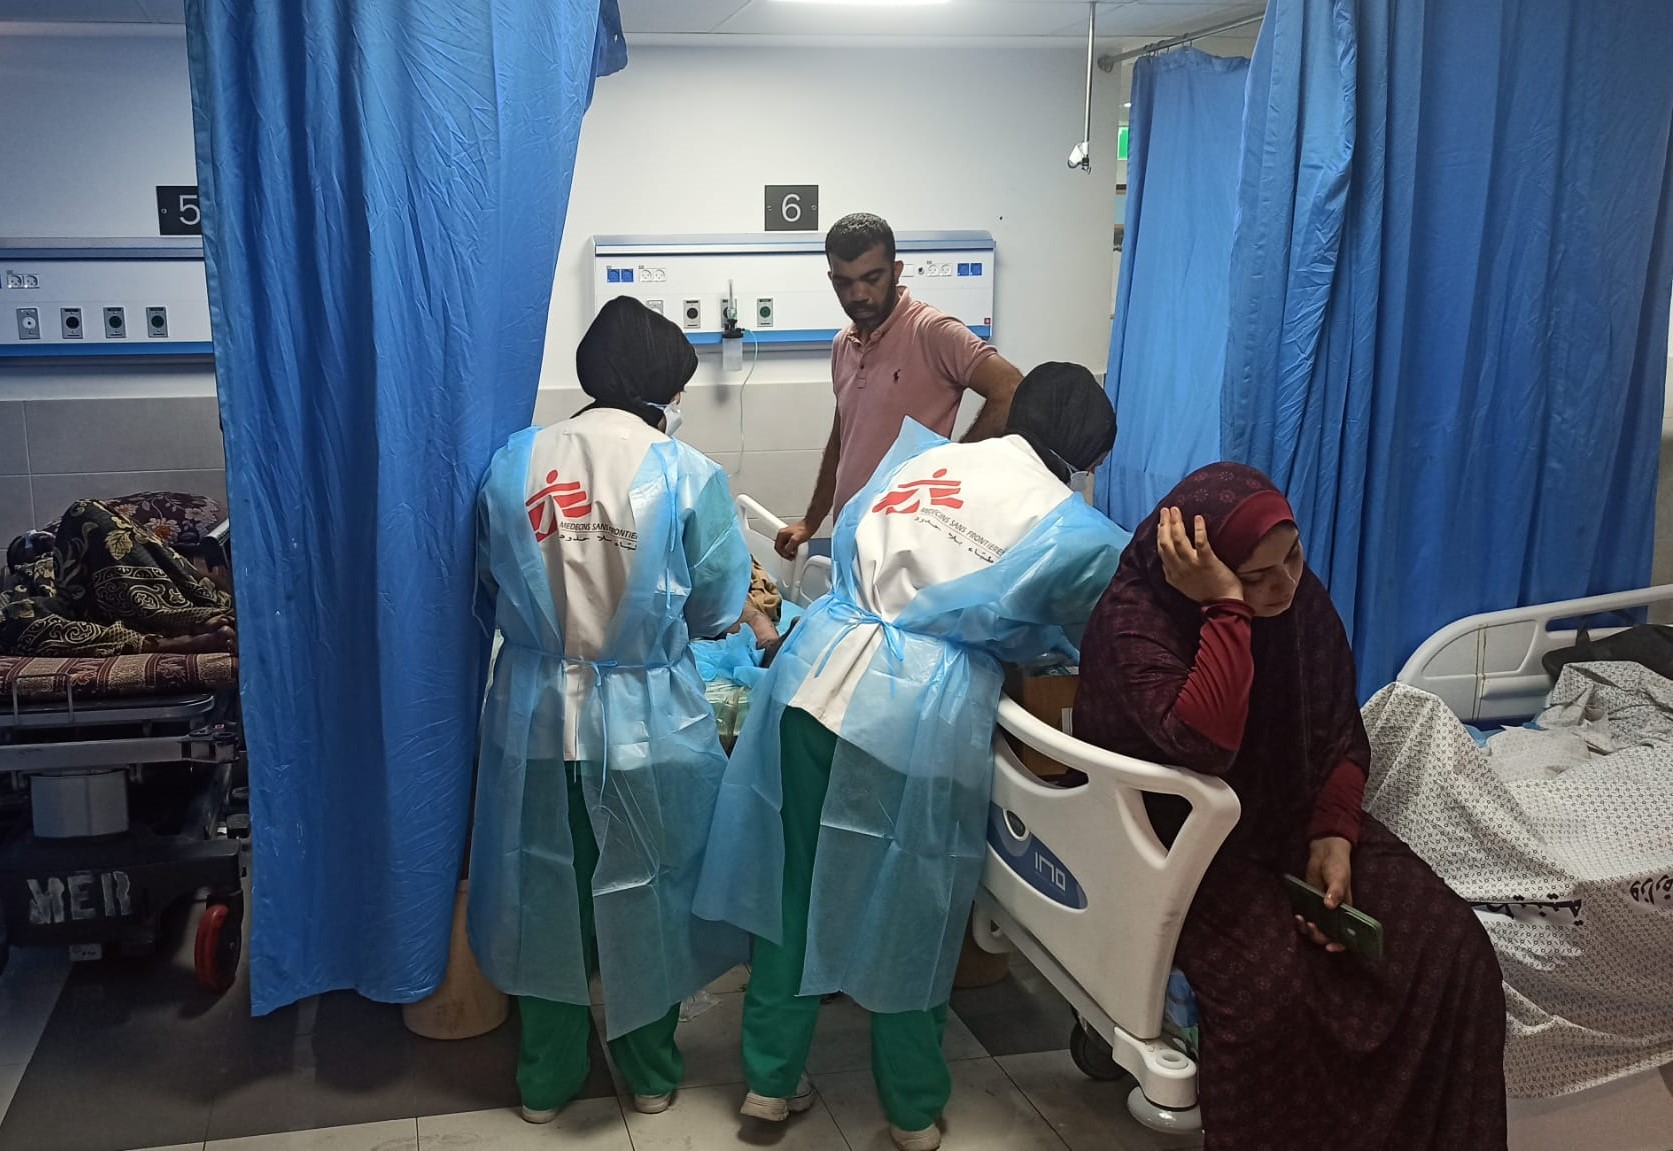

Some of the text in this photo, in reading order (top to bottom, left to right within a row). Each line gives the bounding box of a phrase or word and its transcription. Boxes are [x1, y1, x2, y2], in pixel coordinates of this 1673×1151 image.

[179, 194, 201, 225] 5
[781, 193, 801, 222] 6
[949, 519, 967, 532] SANS
